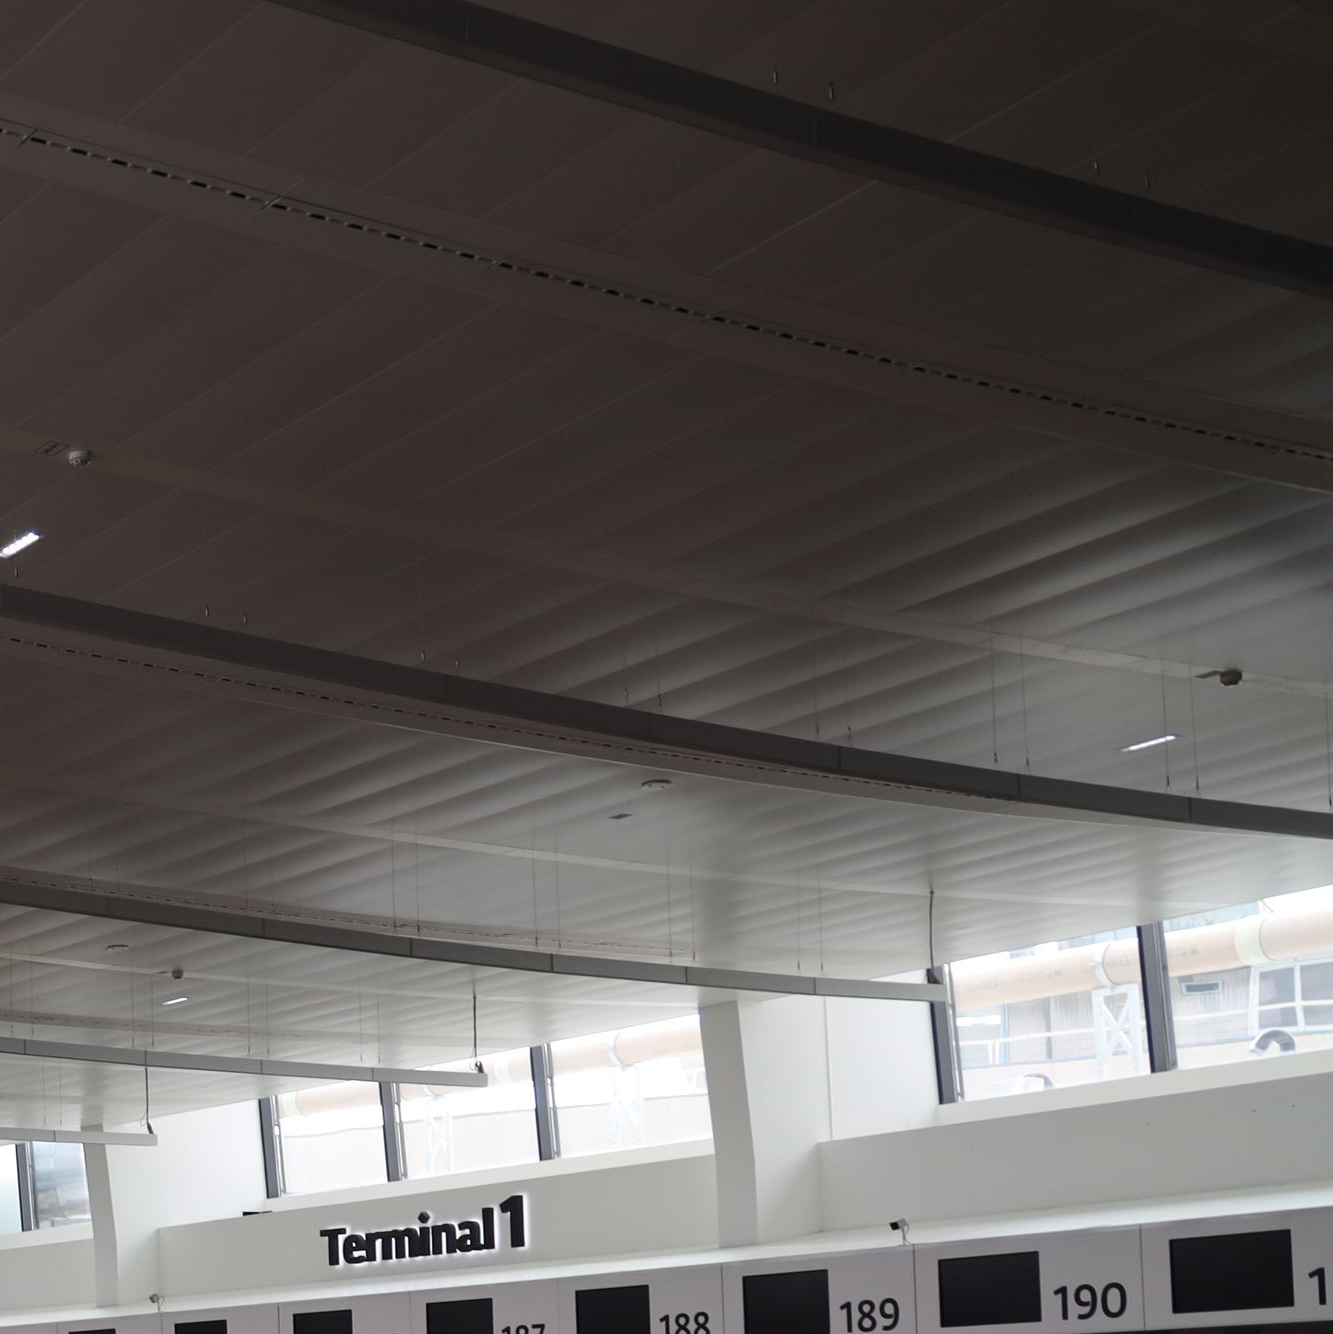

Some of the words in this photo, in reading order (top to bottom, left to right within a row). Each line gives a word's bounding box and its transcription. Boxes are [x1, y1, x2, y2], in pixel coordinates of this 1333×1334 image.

[320, 1207, 494, 1266] Terminal
[499, 1195, 527, 1247] 1
[840, 1298, 899, 1333] 189
[1054, 1283, 1127, 1320] 190
